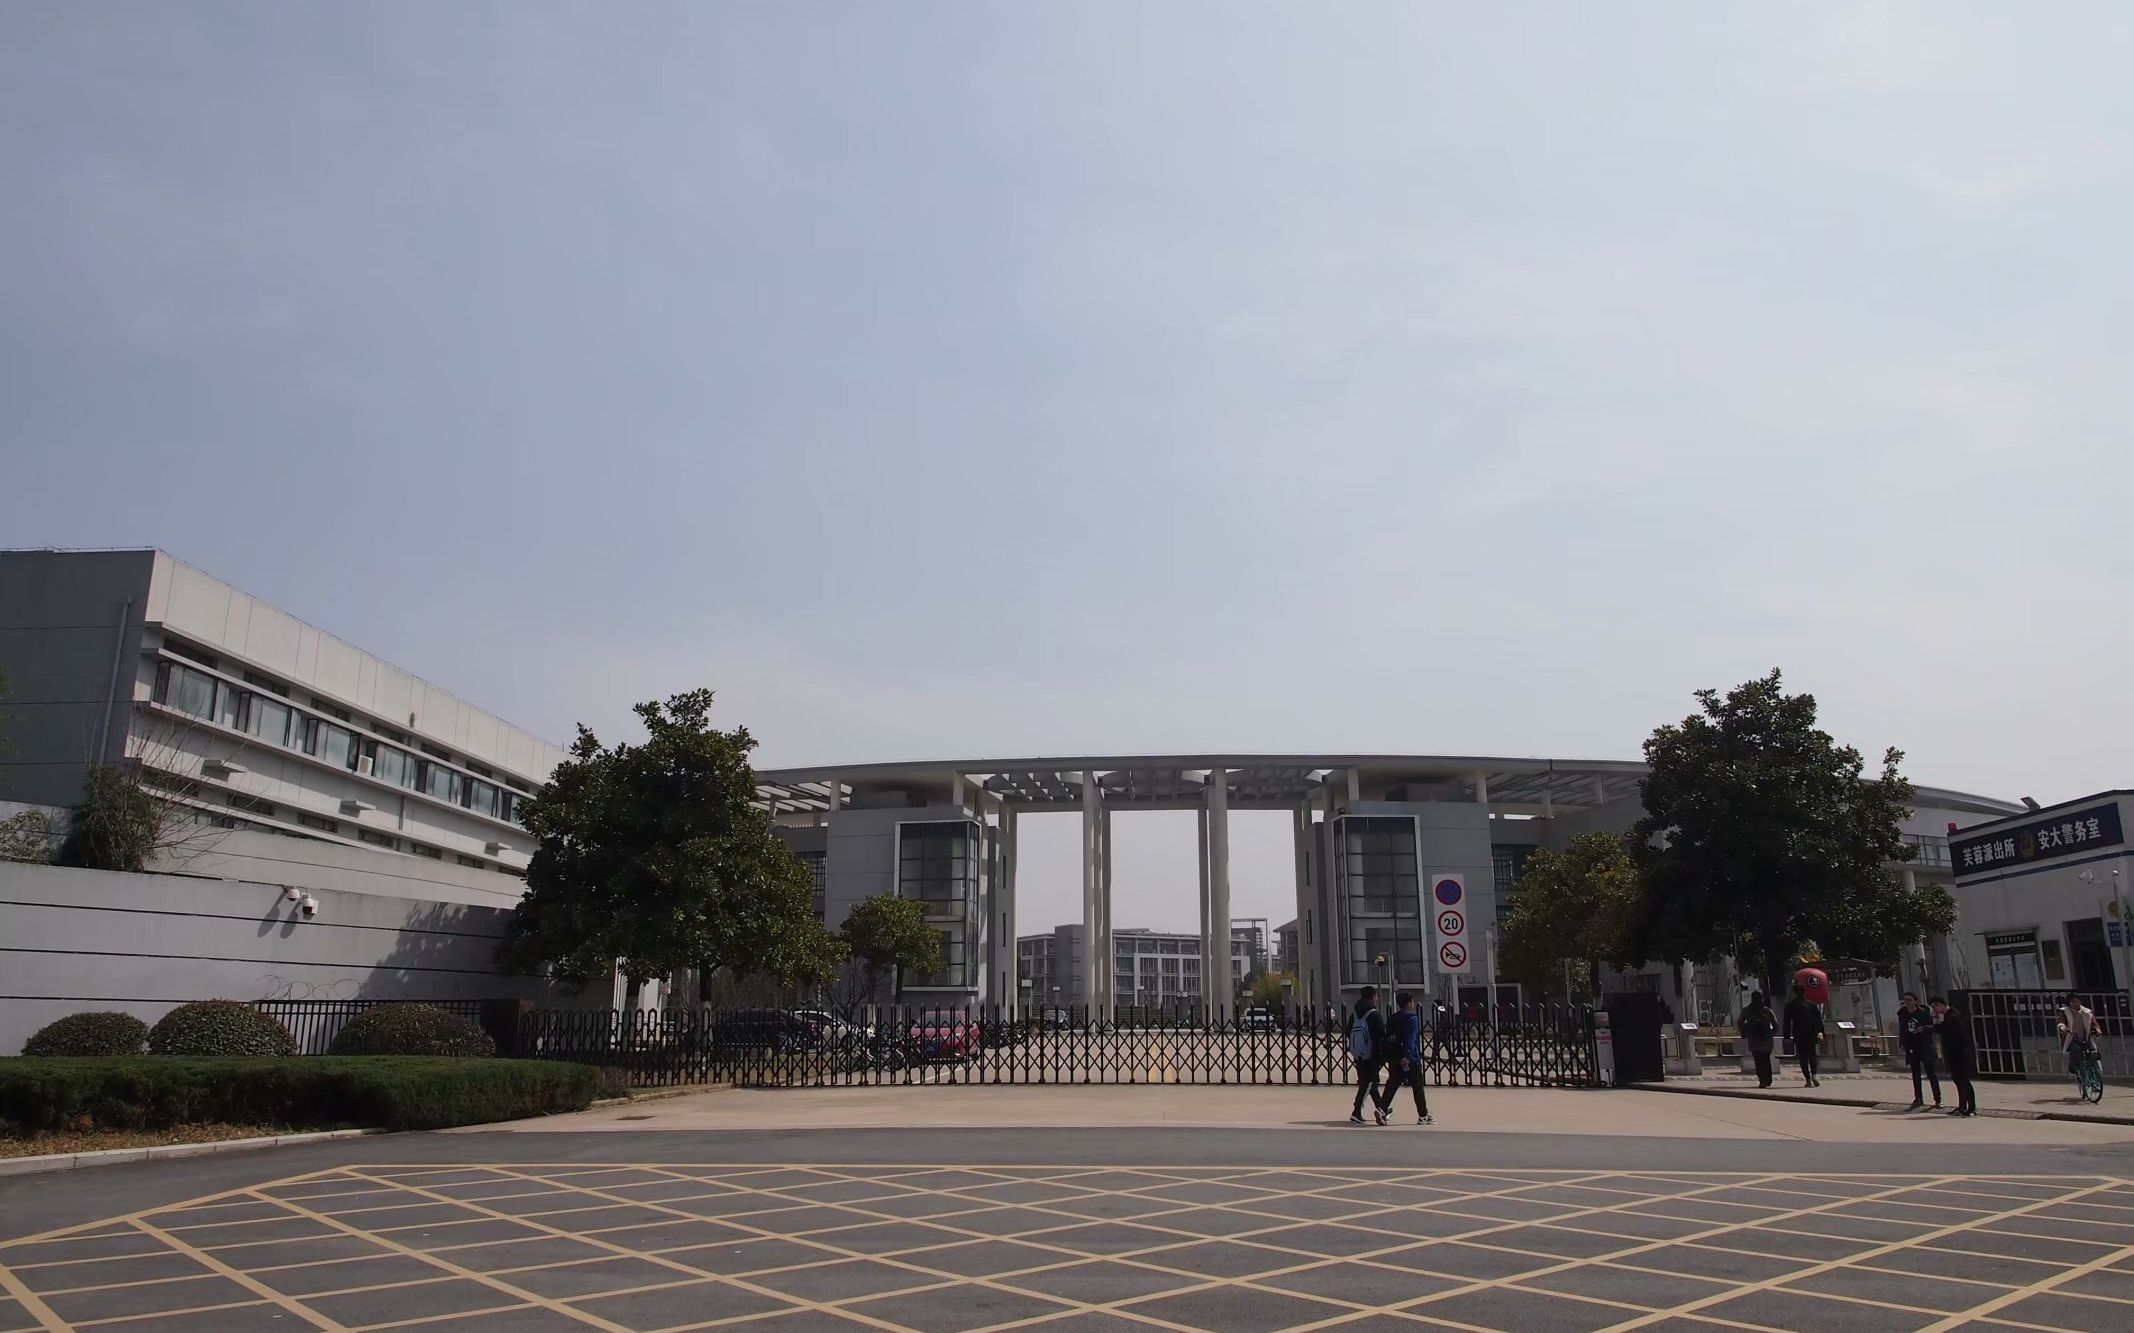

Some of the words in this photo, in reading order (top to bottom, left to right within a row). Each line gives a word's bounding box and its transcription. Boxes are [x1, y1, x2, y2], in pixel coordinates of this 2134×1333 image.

[1962, 838, 2015, 867] 芙蓉派出所
[2037, 817, 2101, 850] 安大警务室
[1444, 918, 1458, 930] 20
